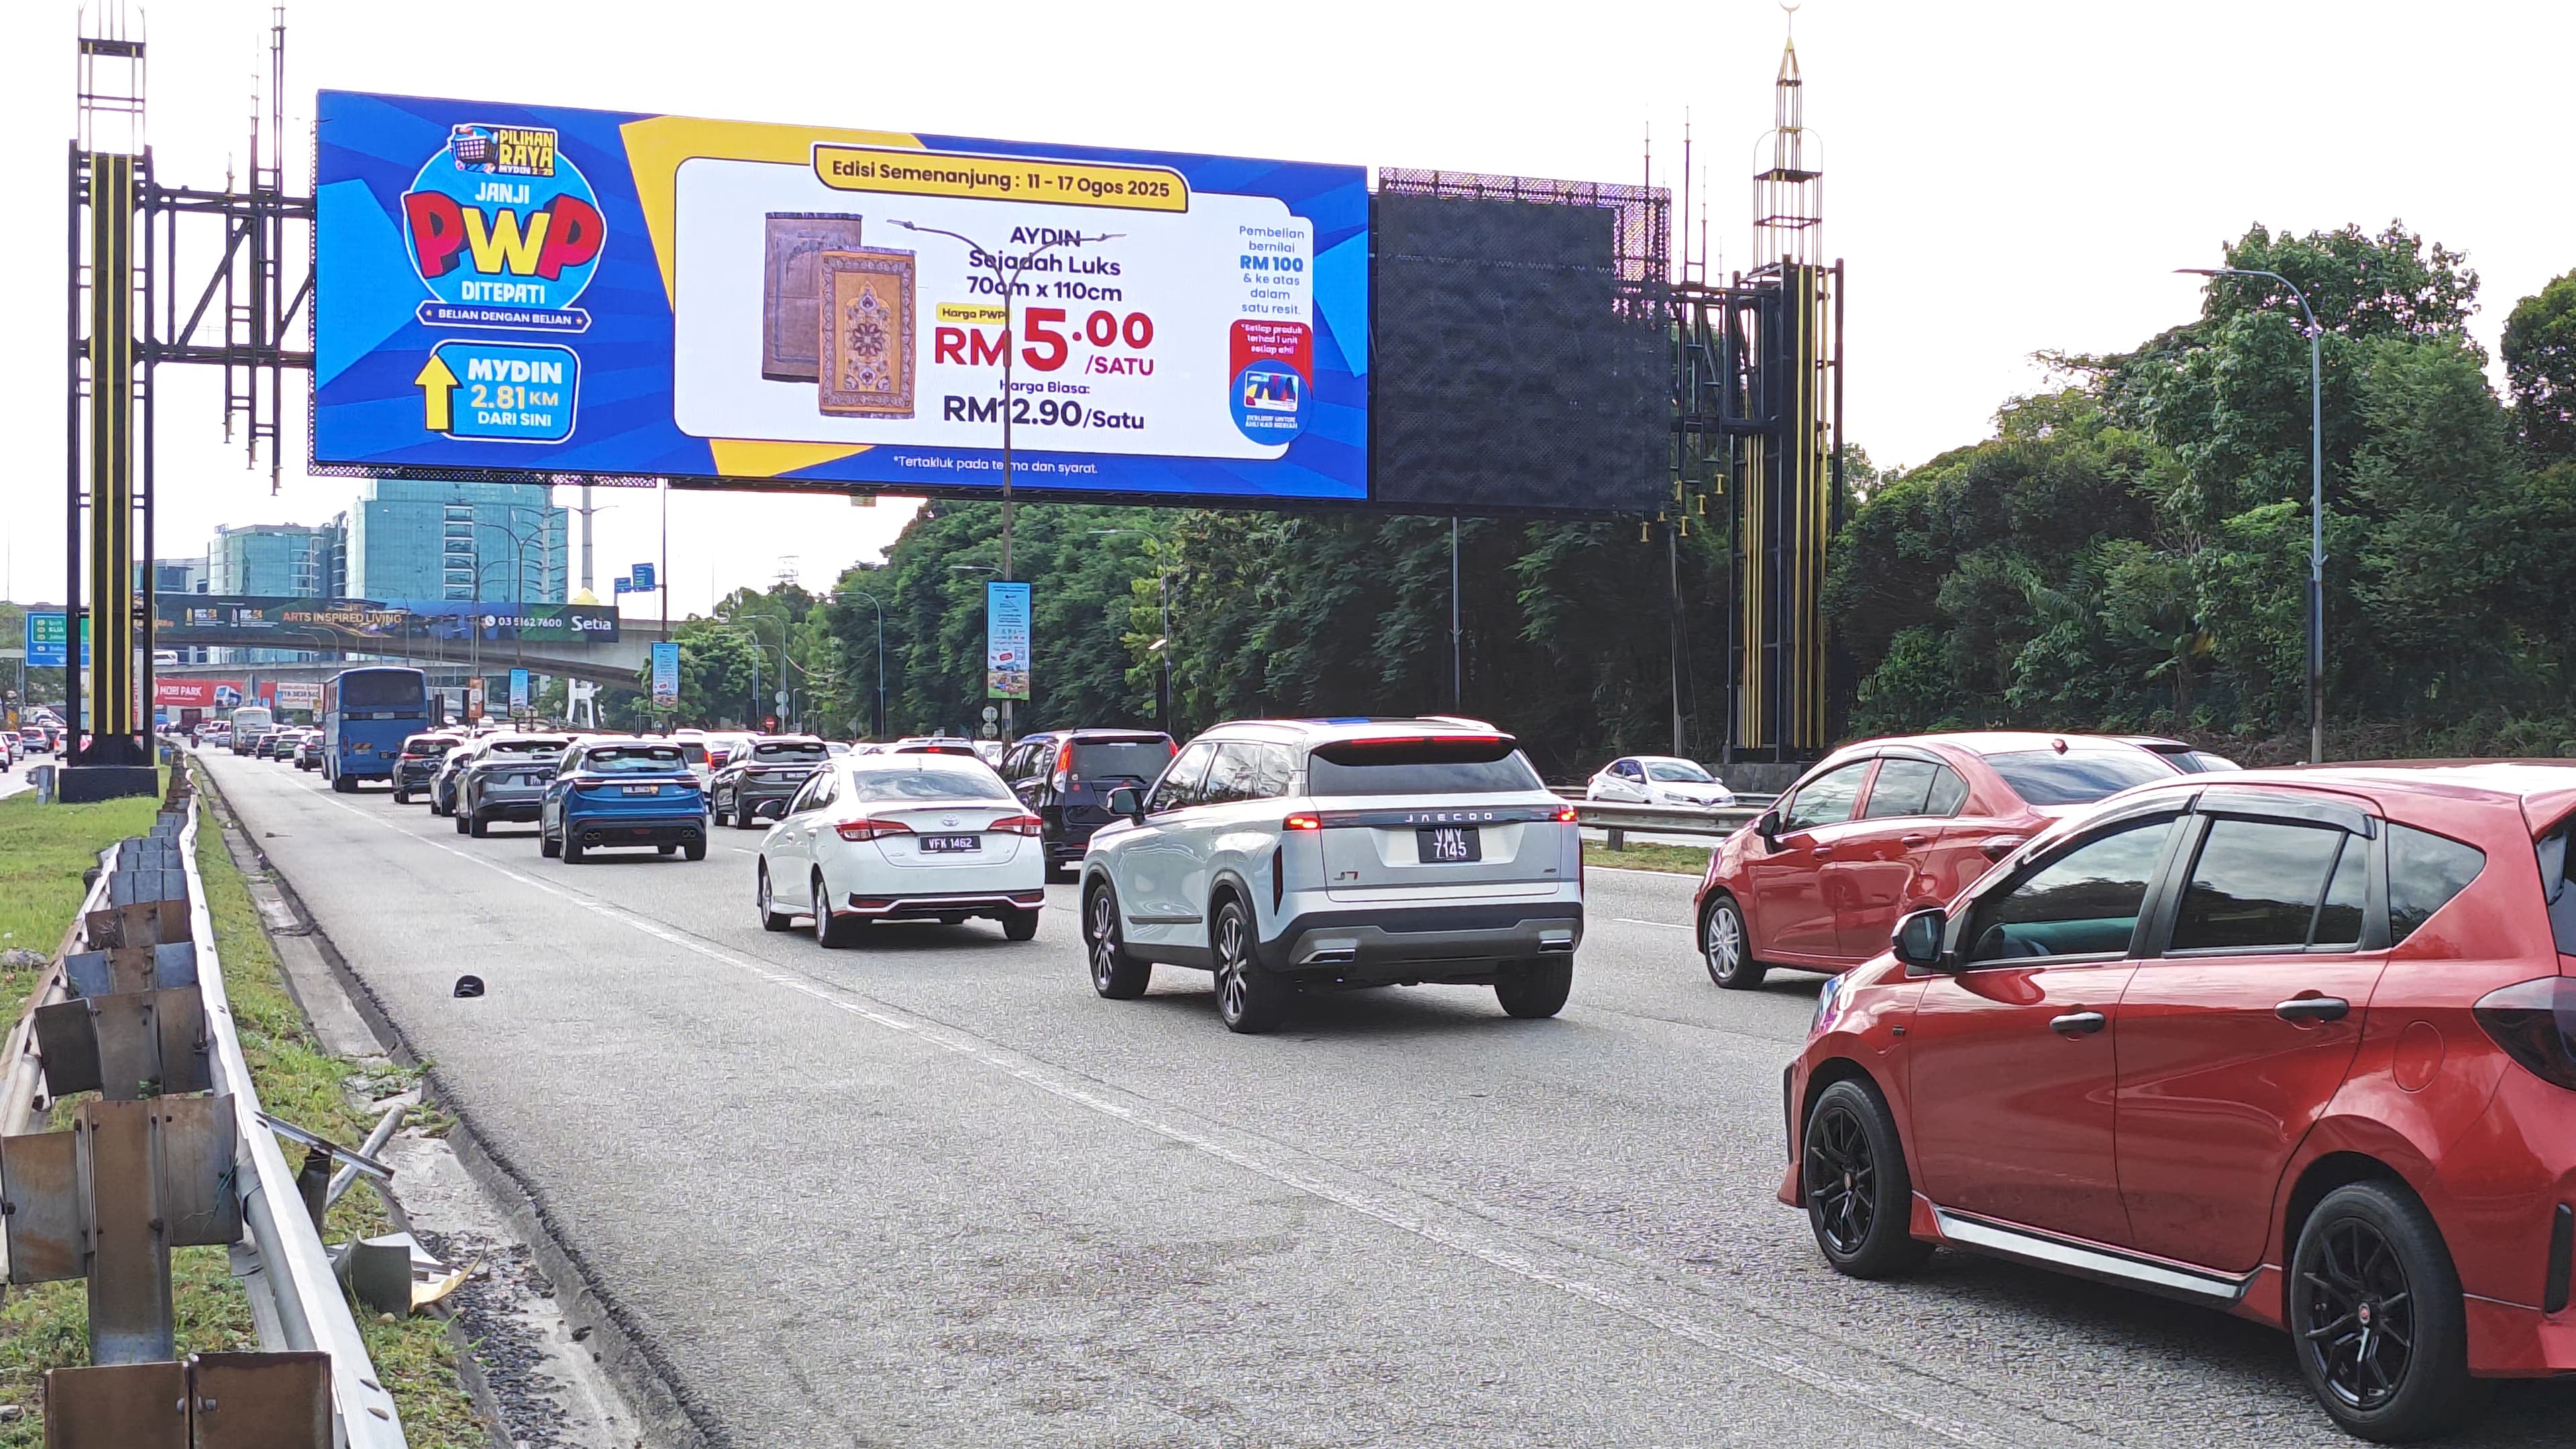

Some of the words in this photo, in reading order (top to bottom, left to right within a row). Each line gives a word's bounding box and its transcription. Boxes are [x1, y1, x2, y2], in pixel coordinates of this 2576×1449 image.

[499, 129, 553, 147] PILIHAN
[499, 144, 553, 168] RAYA
[498, 165, 531, 174] MYDIN
[833, 161, 875, 178] Edisi
[879, 164, 1012, 191] Semenanjung
[1027, 174, 1040, 189] 11
[1058, 176, 1073, 190] 17
[1077, 178, 1123, 197] Ogos
[1128, 180, 1169, 197] 2025
[475, 182, 530, 204] JANJI
[404, 192, 604, 280] PWP
[1010, 226, 1081, 247] AYDIN
[1239, 225, 1305, 239] Pembelian
[1248, 241, 1295, 254] bernilai
[969, 250, 1063, 273] Sejadah
[1069, 256, 1121, 276] Luks
[1240, 255, 1269, 271] RM
[1273, 256, 1304, 272] 100
[1243, 273, 1252, 283] &
[1255, 274, 1270, 284] ke
[1273, 275, 1300, 286] atas
[462, 281, 545, 305] DITEPATI
[966, 276, 1030, 297] 70cm
[1036, 284, 1049, 297] x
[1054, 280, 1122, 301] 110cm
[1250, 287, 1290, 301] dalam
[438, 309, 479, 321] BELIAN
[481, 311, 530, 323] DENGAN
[532, 313, 572, 325] BELIAN
[942, 308, 977, 320] Harga
[979, 309, 1006, 319] PWP
[1242, 304, 1268, 314] satu
[468, 358, 562, 384] MYDIN
[1085, 356, 1154, 376] /SATU
[1047, 381, 1090, 394] Biasa:
[471, 386, 526, 409] 2.81
[530, 392, 558, 407] KM
[478, 411, 517, 426] DARI
[521, 413, 551, 427] SINI
[957, 458, 989, 472] pada
[992, 460, 1028, 472] tema
[1032, 460, 1055, 472] dan
[1058, 462, 1098, 476] syarat.
[282, 611, 311, 622] ARTS
[313, 612, 364, 623] INSPIRED
[366, 614, 402, 625] LIVING
[498, 617, 511, 626] 03
[537, 618, 562, 628] 7600
[571, 615, 612, 632] Setia
[180, 686, 203, 697] PARK
[1405, 812, 1493, 822] JAECOO
[928, 838, 947, 849] VFK
[950, 837, 973, 849] 1462
[1435, 828, 1462, 843] VMY
[1433, 842, 1467, 858] 7145
